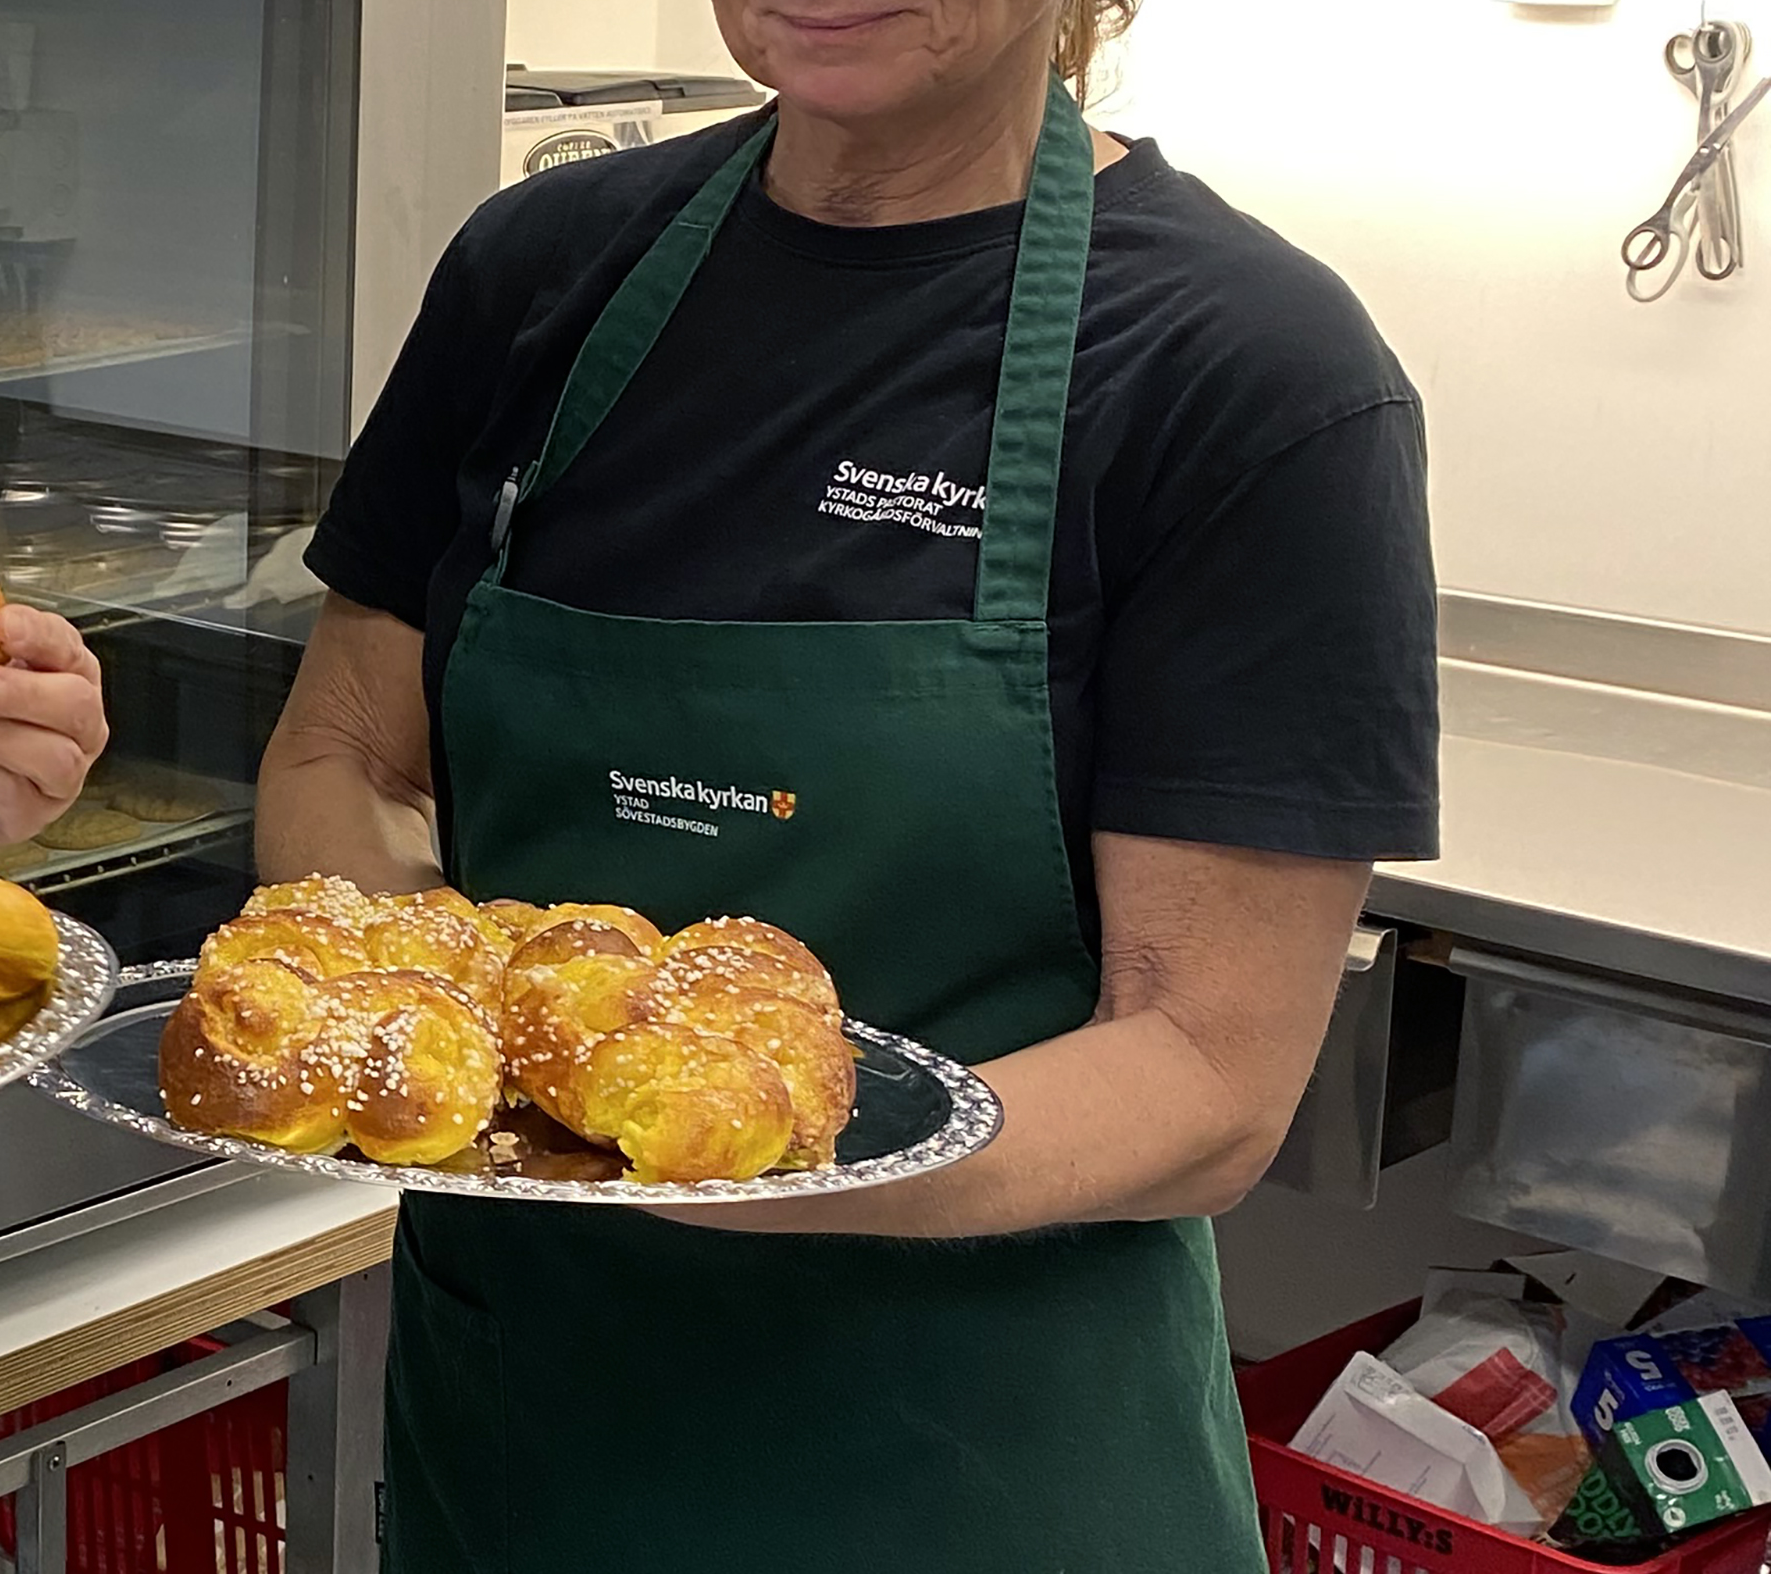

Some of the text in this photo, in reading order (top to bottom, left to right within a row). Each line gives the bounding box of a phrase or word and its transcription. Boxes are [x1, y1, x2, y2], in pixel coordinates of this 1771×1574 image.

[833, 460, 930, 493] Svenska
[826, 485, 876, 508] YSTADS
[609, 770, 768, 814] Svenska kyrkan
[613, 794, 649, 810] YSTAD
[615, 805, 719, 837] SÖVESTADSBYGDEN
